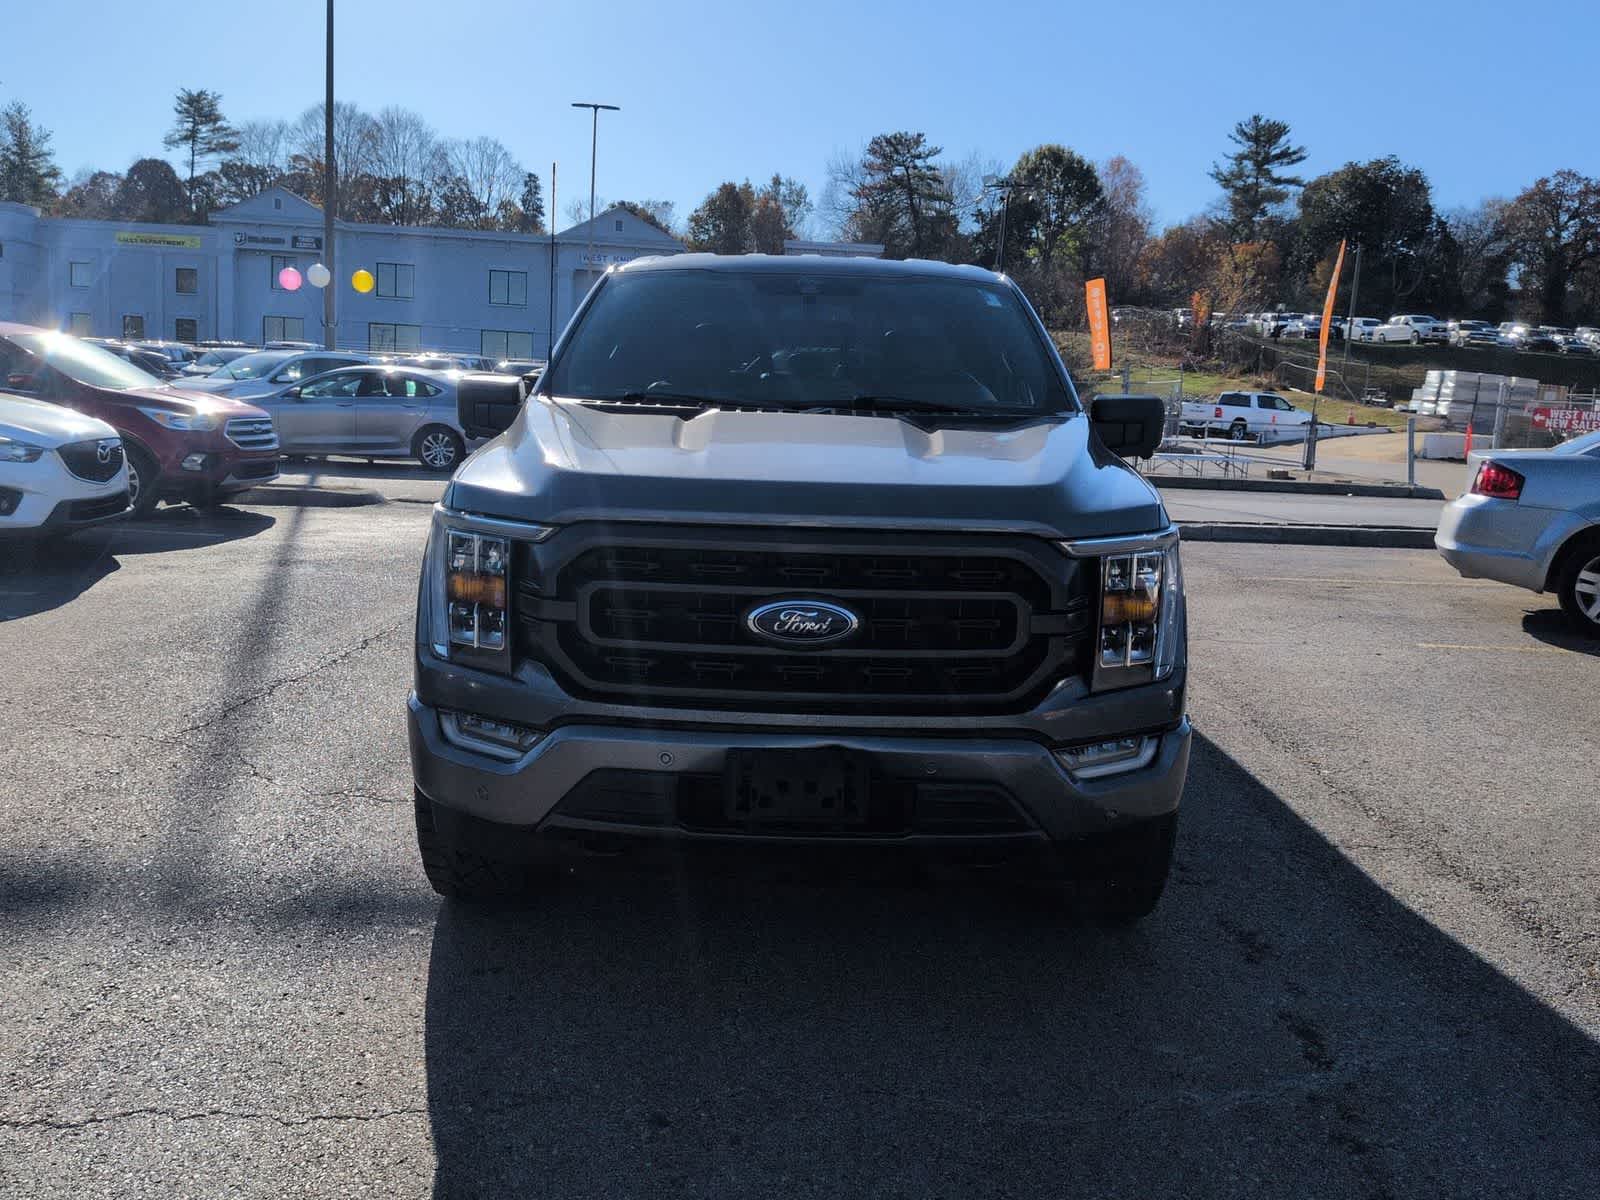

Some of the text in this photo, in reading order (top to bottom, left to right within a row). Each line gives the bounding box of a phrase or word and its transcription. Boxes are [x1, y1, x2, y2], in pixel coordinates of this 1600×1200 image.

[583, 254, 608, 262] WEST
[1550, 409, 1579, 419] WEST
[1545, 418, 1600, 431] NEW SALE
[774, 610, 832, 634] Ford
